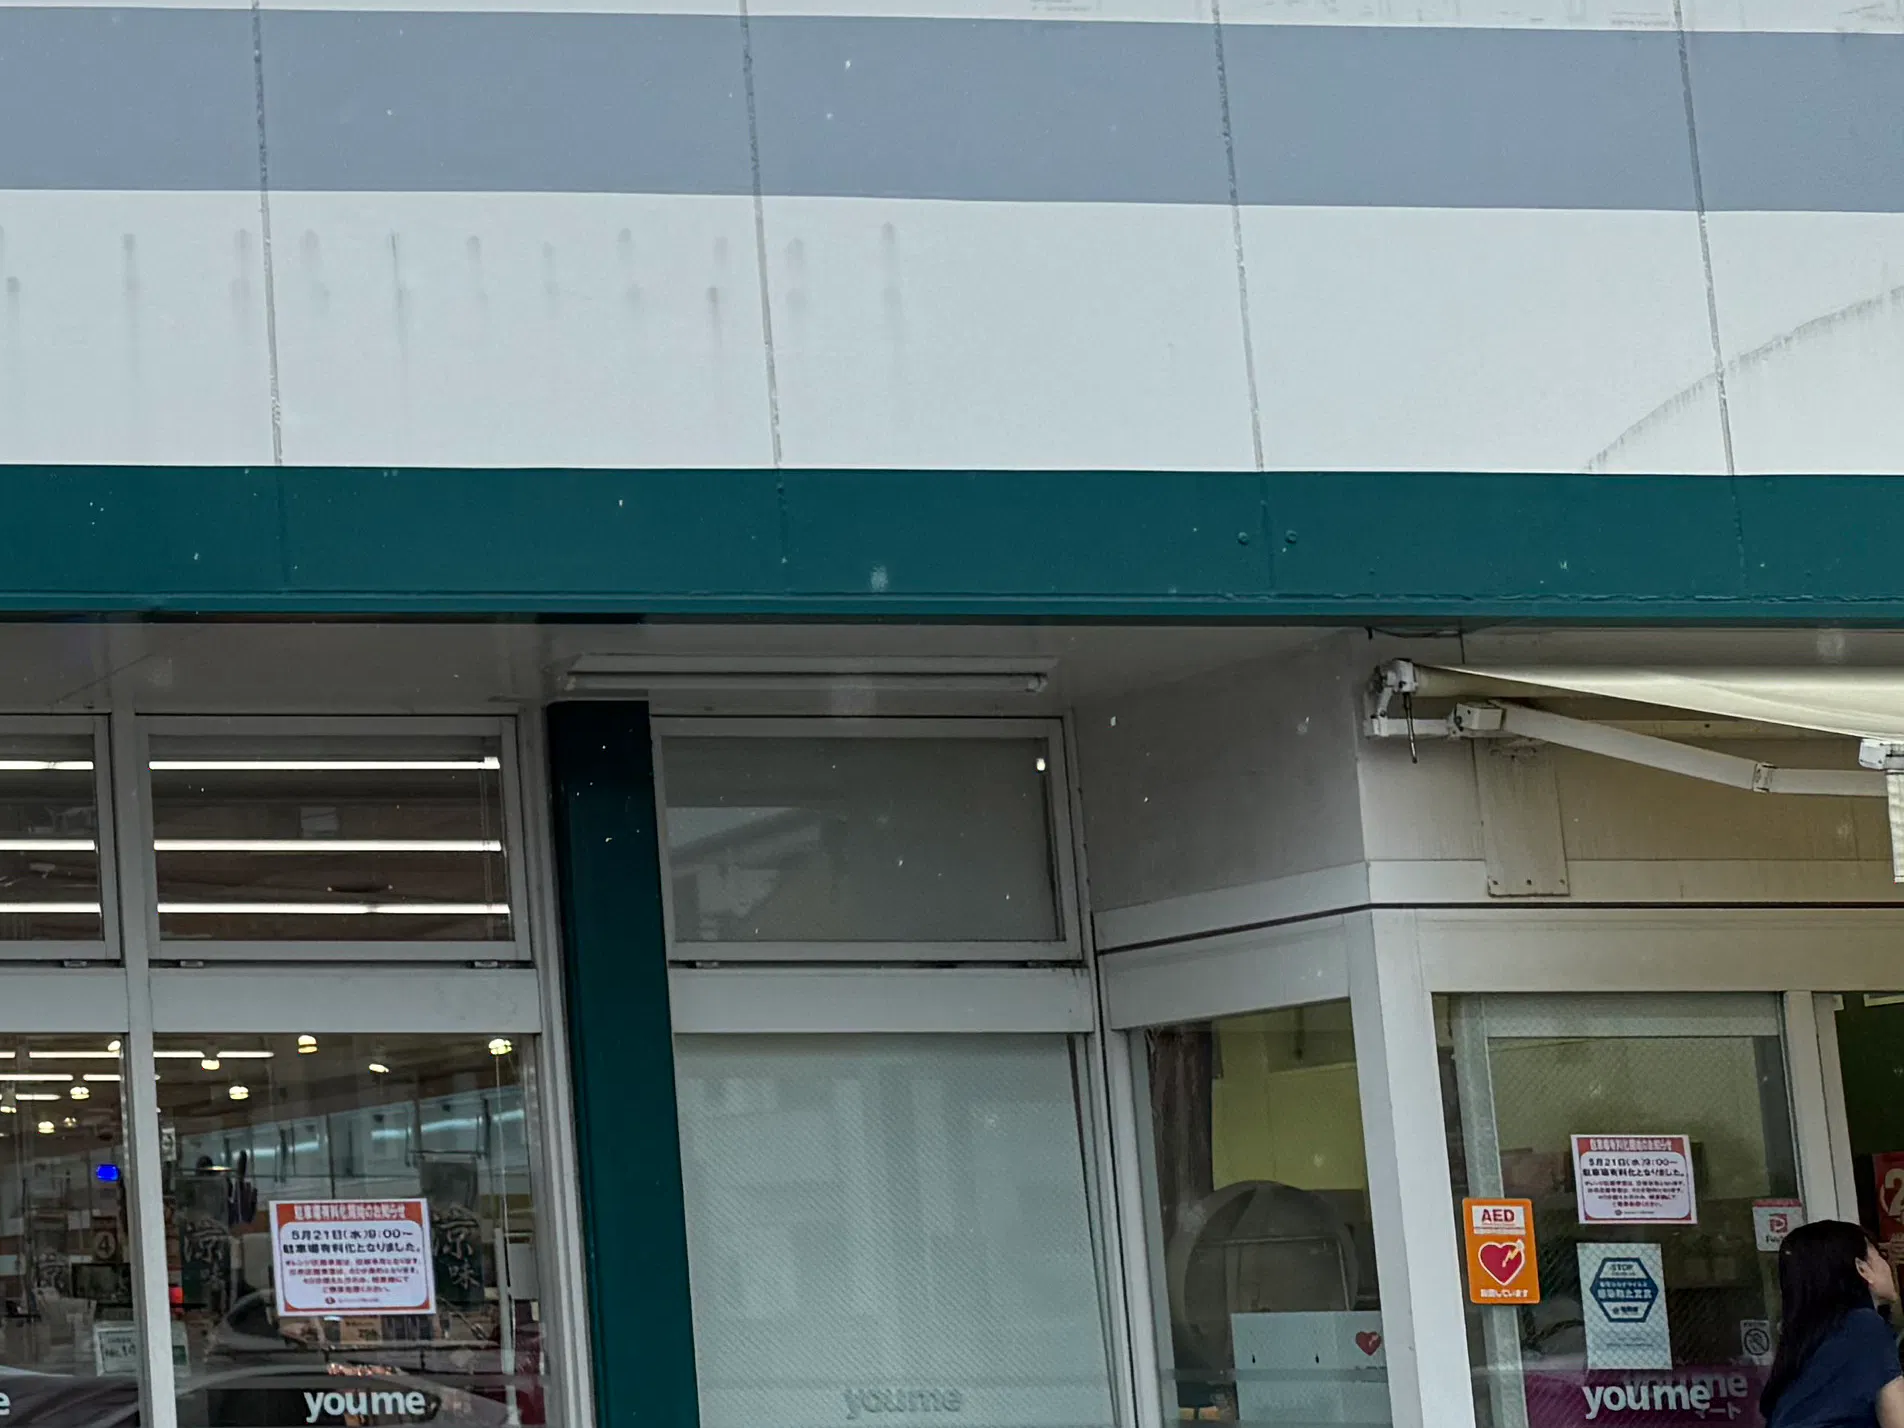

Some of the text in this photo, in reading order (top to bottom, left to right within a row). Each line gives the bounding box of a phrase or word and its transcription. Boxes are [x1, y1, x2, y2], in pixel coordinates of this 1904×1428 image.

[1481, 1209, 1515, 1222] AED
[304, 1389, 426, 1423] youme
[1581, 1383, 1711, 1420] youme
